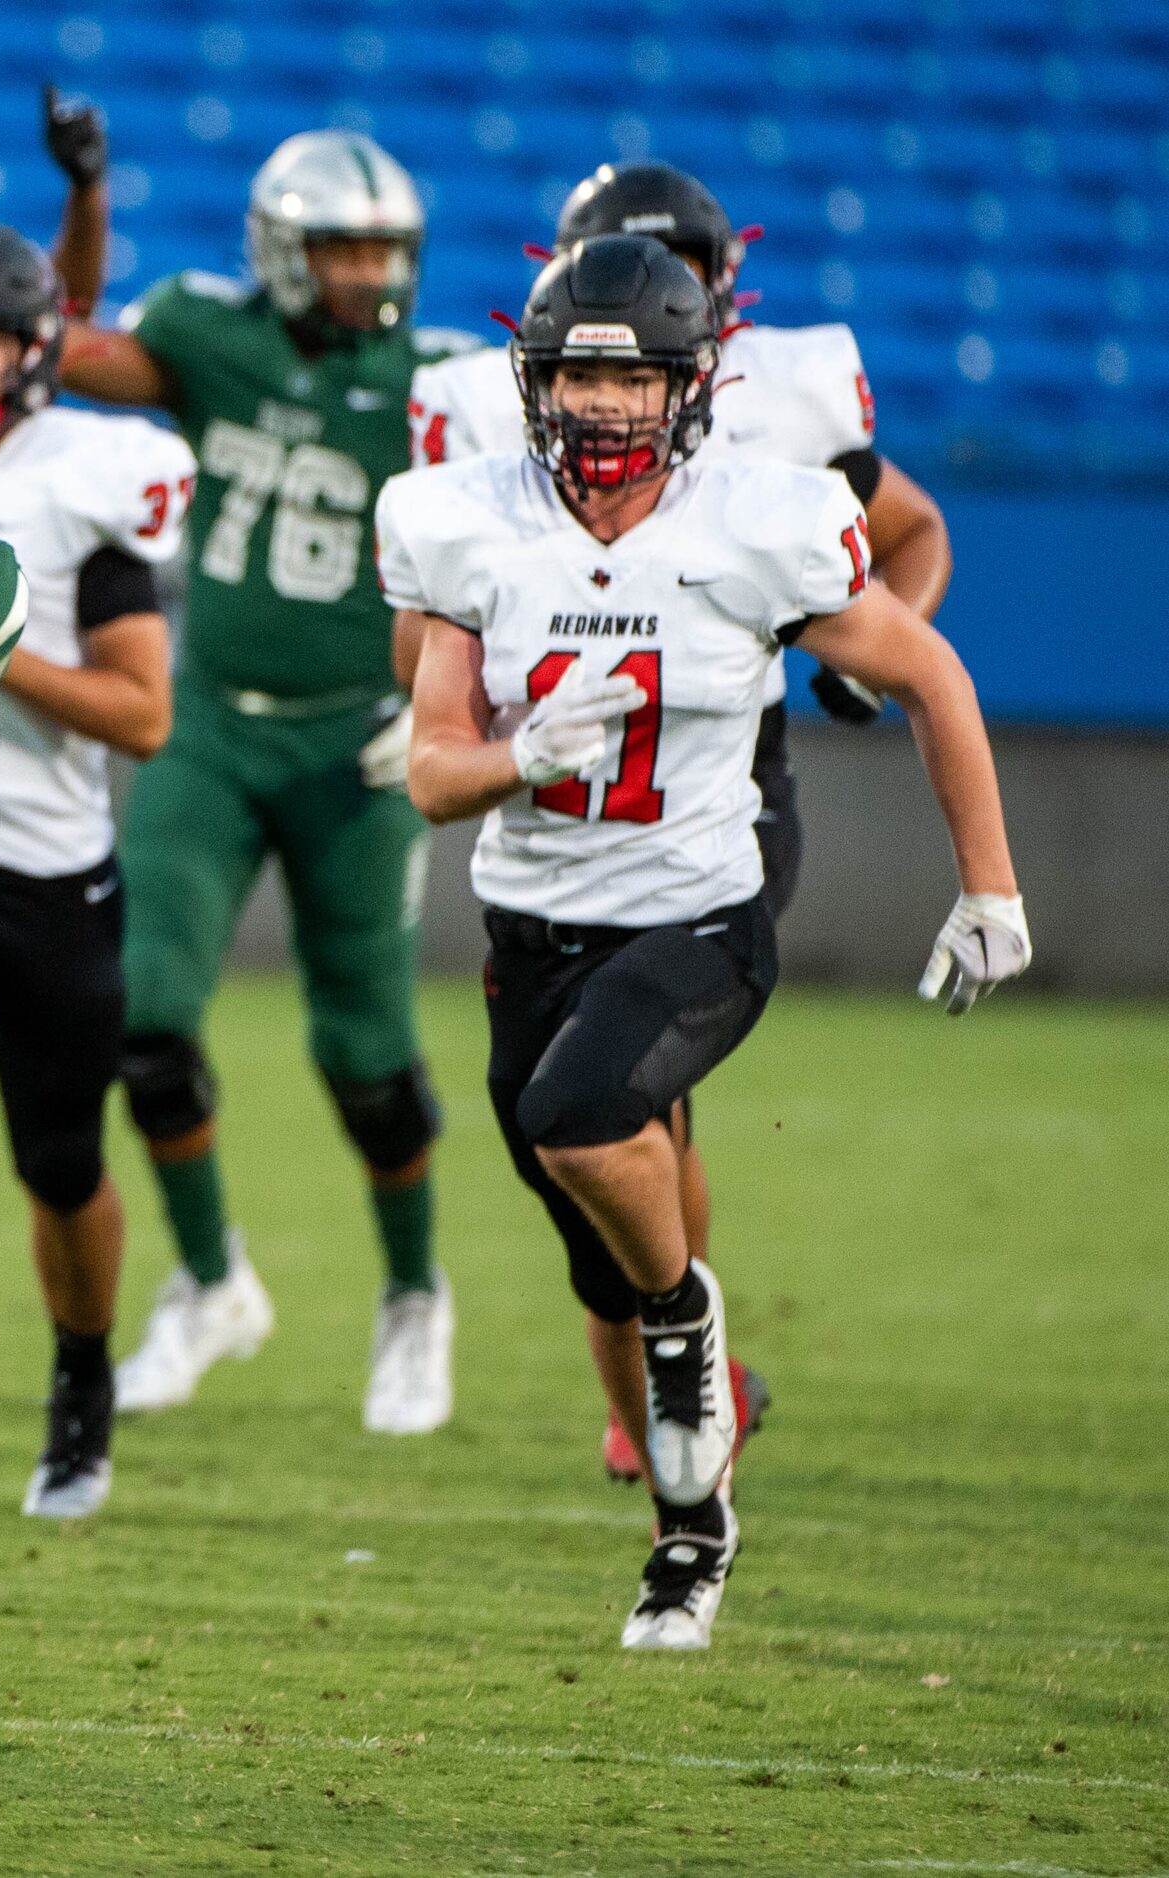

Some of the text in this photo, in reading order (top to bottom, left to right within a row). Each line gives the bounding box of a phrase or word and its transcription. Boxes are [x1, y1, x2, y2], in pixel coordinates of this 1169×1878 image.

[575, 331, 627, 341] Riddell
[201, 417, 370, 603] 76
[549, 613, 658, 637] REDHAWKS
